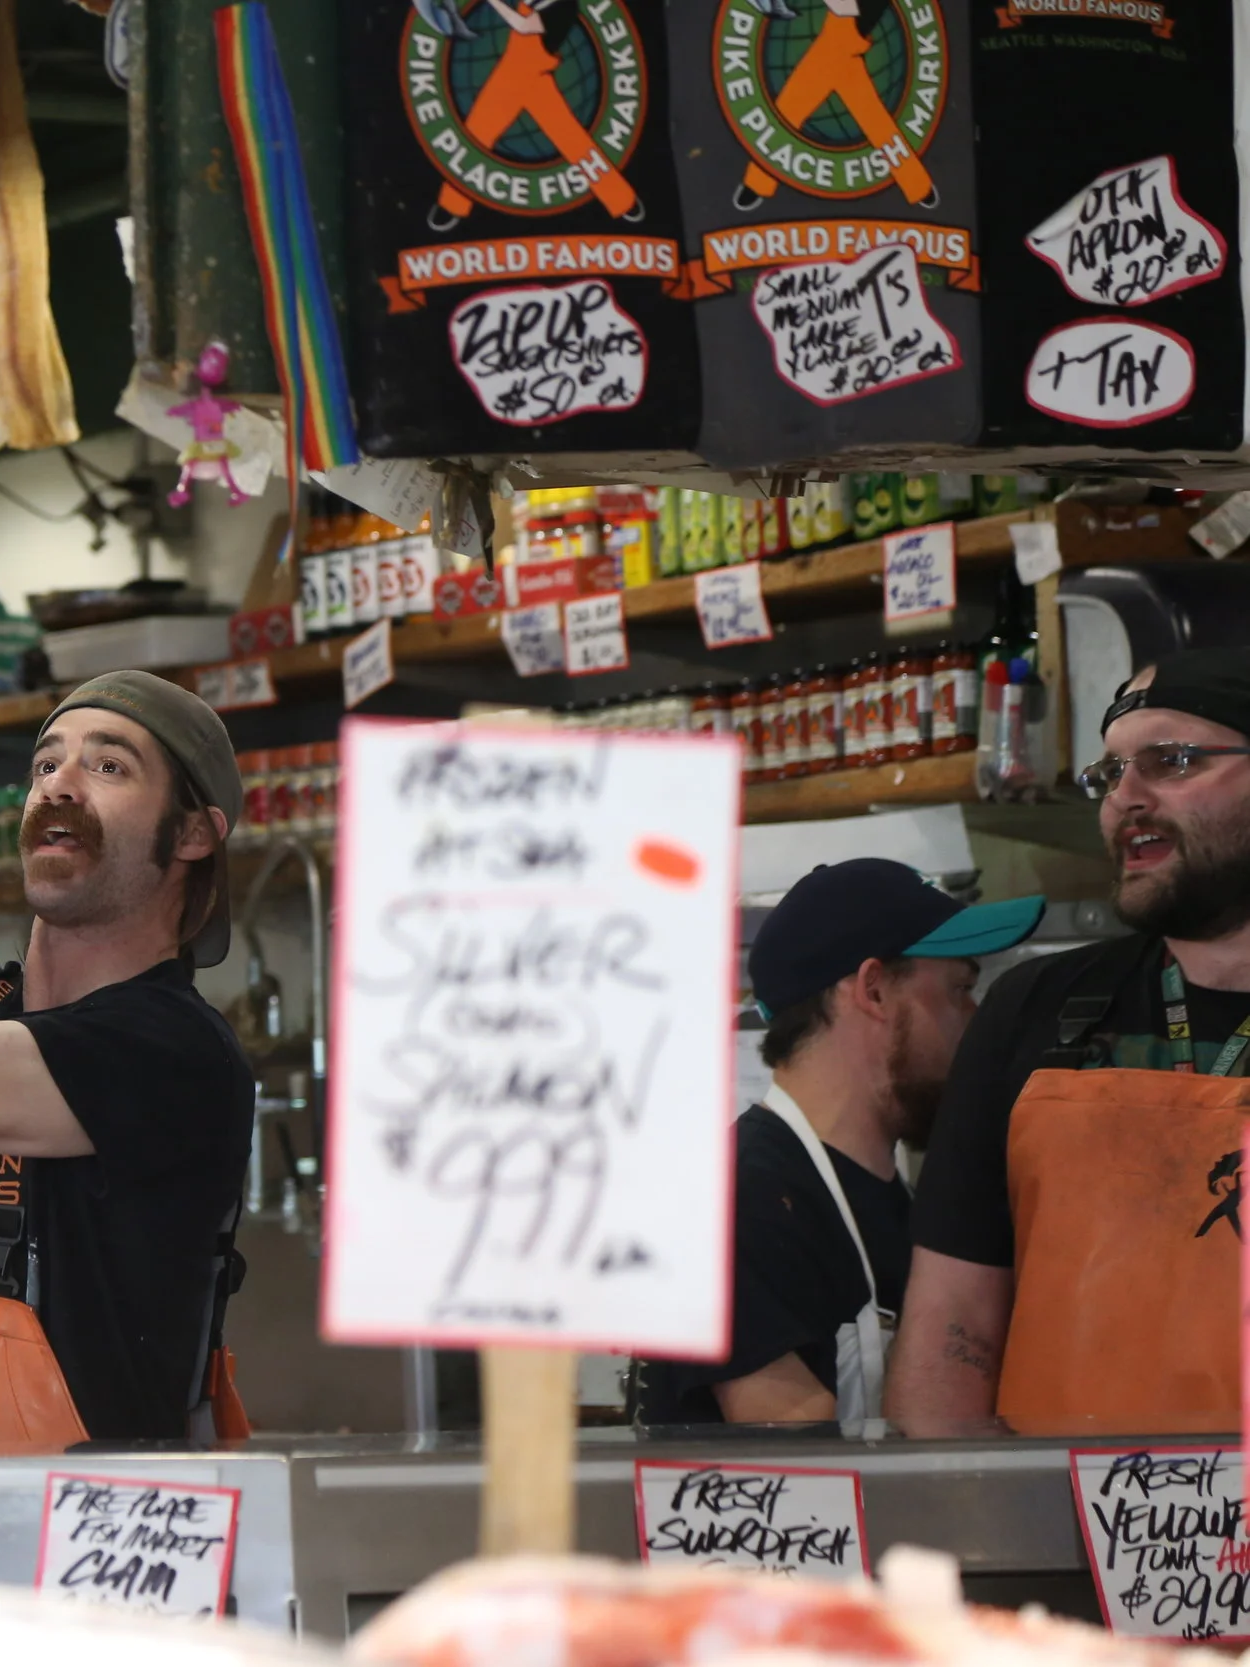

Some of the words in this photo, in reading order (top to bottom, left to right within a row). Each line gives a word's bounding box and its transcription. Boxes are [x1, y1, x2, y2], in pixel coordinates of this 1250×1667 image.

[1013, 0, 1082, 12] WORLD
[1086, 0, 1163, 24] FAMOUS
[723, 8, 756, 101] PIKE
[904, 0, 941, 138] MARKE
[979, 33, 1047, 51] SEATTLE
[409, 33, 445, 125] PIKE
[431, 128, 530, 206] PLACE
[538, 149, 610, 205] FISH
[586, 0, 640, 151] MARKET
[739, 106, 835, 188] PLACE
[843, 134, 911, 188] FISH
[708, 226, 830, 265] WORLD
[1067, 186, 1168, 276] APRON
[404, 242, 529, 281] WORLD
[536, 239, 675, 272] FAMOUS
[757, 266, 841, 306] SMALL
[1078, 334, 1167, 407] TAX
[671, 1466, 791, 1525] FRESH
[1099, 1449, 1229, 1500] FRESH
[58, 1548, 177, 1604] CLAM
